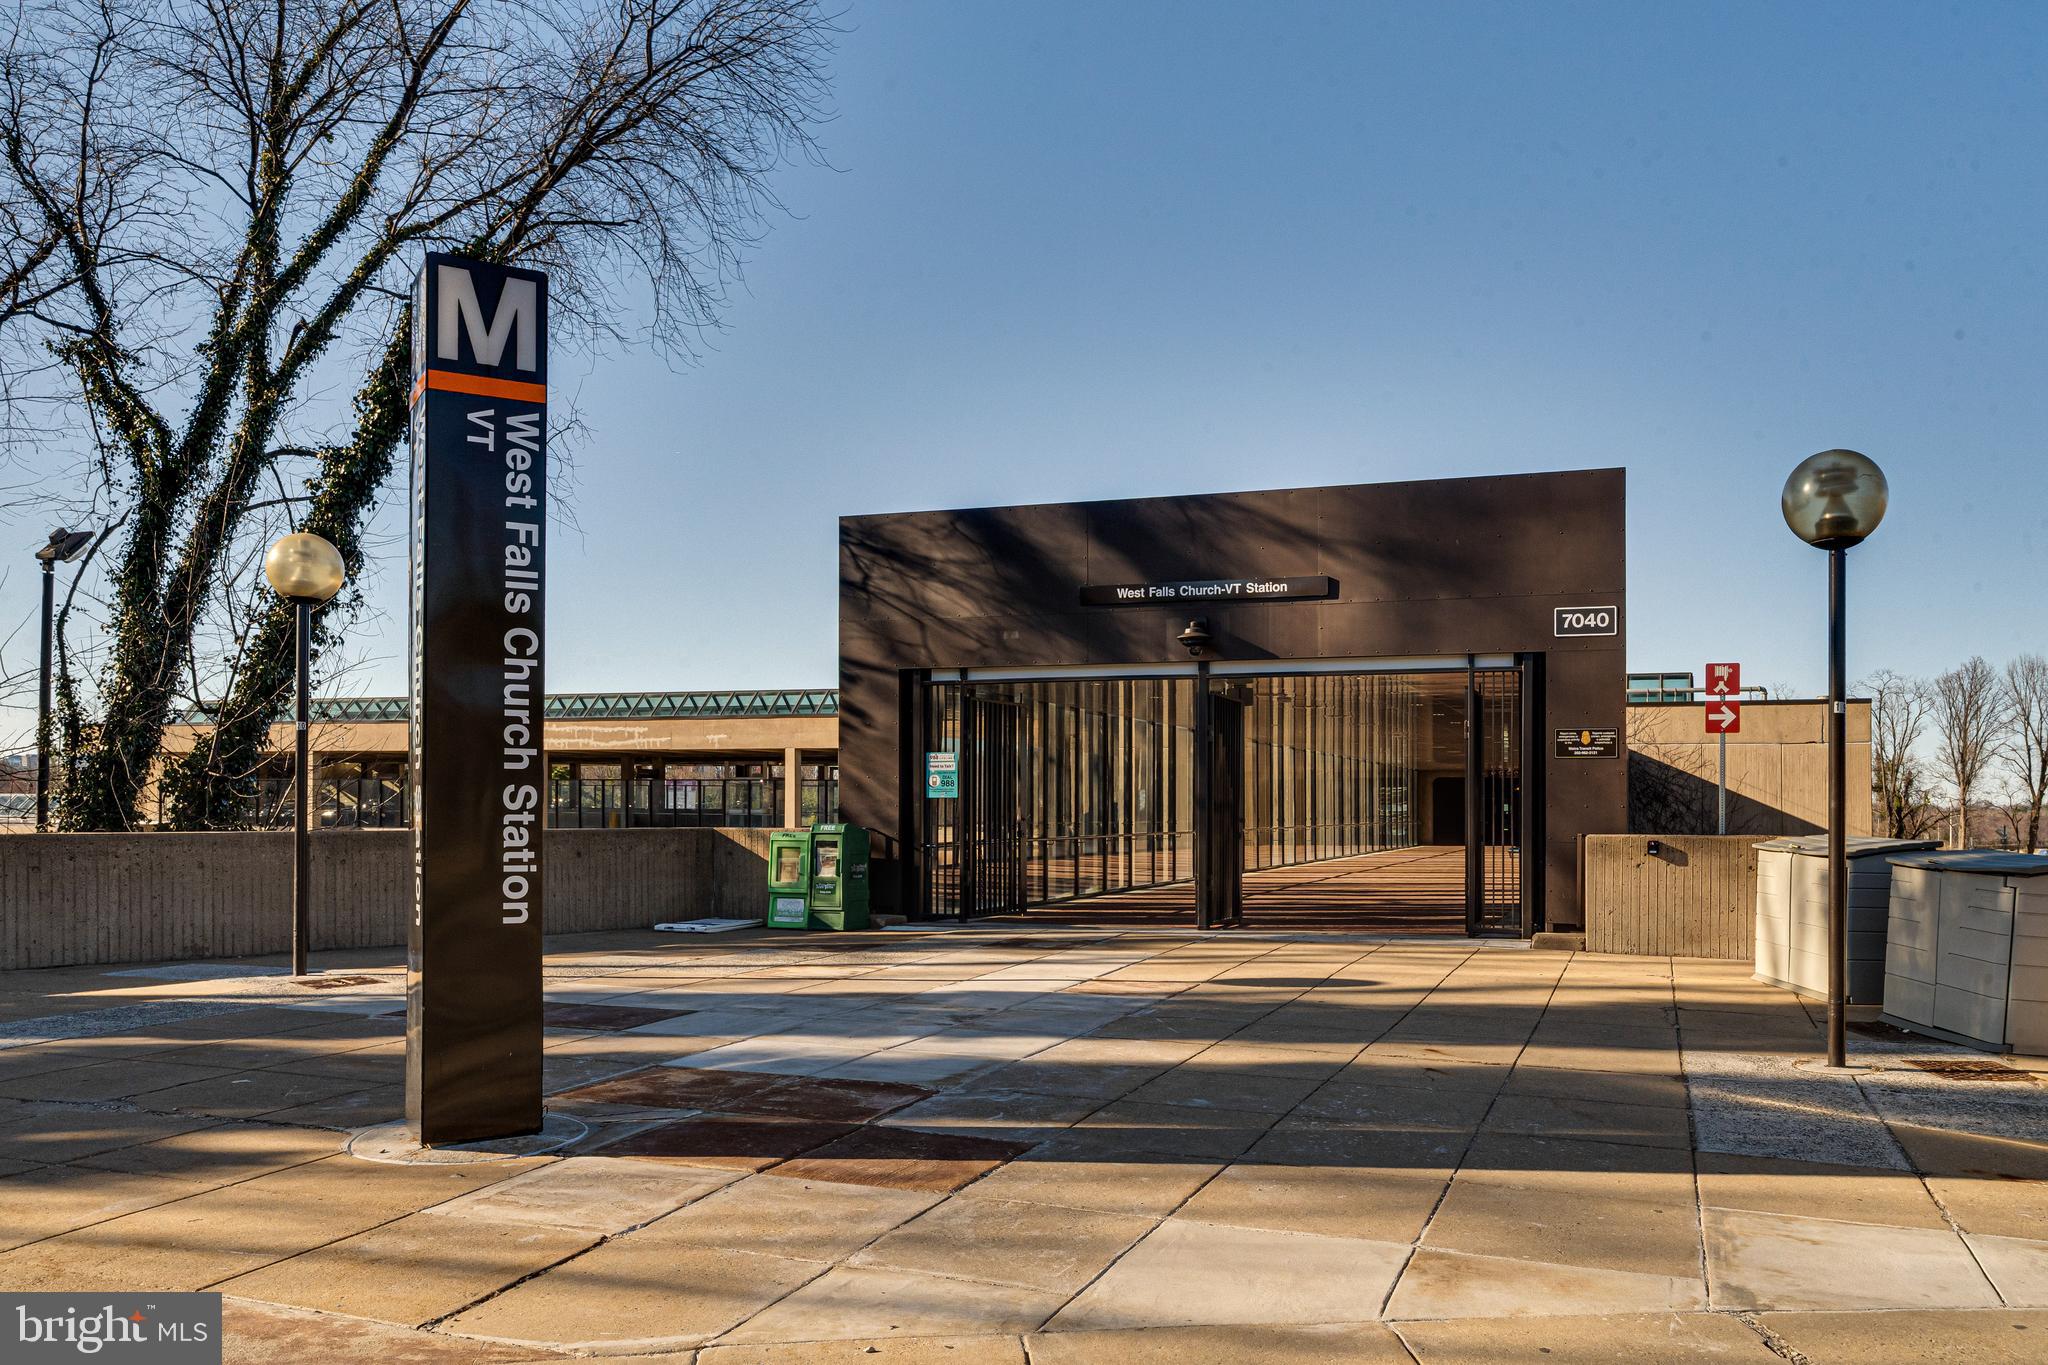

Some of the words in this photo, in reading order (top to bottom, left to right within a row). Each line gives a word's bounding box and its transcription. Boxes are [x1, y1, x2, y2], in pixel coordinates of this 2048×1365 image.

[437, 264, 537, 372] M
[467, 408, 494, 452] VT
[505, 413, 540, 509] West
[504, 522, 539, 614] Falls
[1117, 587, 1145, 599] West
[1149, 586, 1175, 598] Falls
[1179, 583, 1242, 597] Church-VT
[1246, 581, 1288, 594] Station
[1561, 612, 1610, 628] 7040
[503, 627, 539, 770] Church
[502, 784, 538, 925] Station
